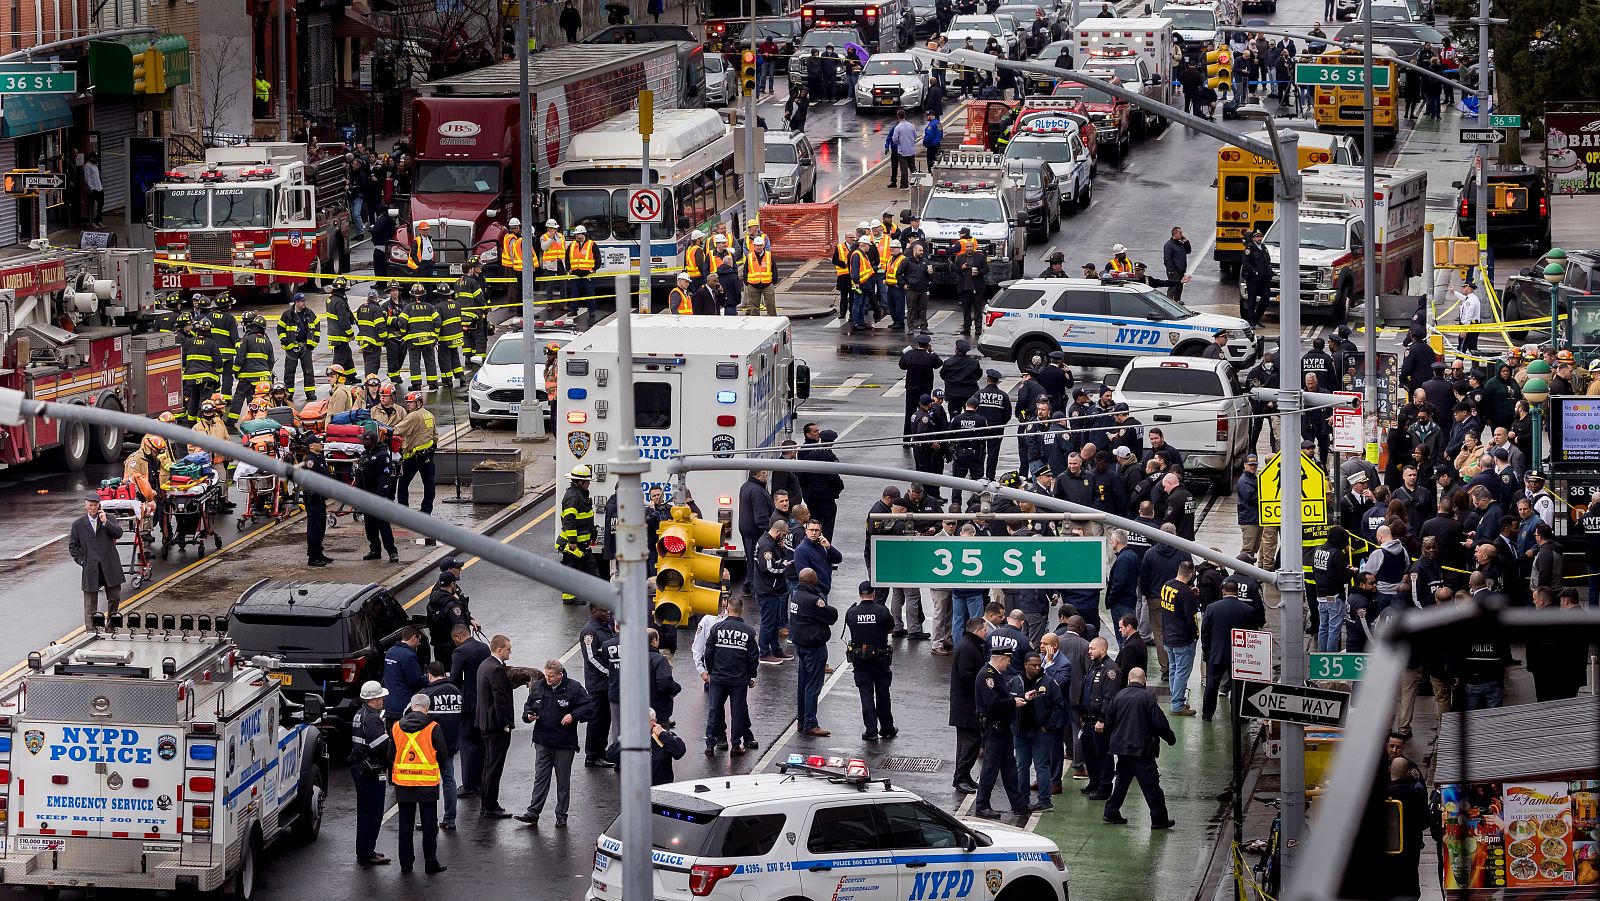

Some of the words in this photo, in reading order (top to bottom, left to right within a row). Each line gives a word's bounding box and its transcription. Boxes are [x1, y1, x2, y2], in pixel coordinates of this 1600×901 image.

[1319, 68, 1340, 82] 36
[1346, 69, 1365, 82] St
[6, 76, 27, 90] 36
[34, 76, 52, 89] St
[1493, 116, 1505, 126] 36
[444, 124, 473, 133] JBS
[440, 138, 476, 146] CARRIERS
[1586, 152, 1600, 164] OP
[2, 272, 24, 289] LADDER
[24, 272, 32, 288] 114
[42, 268, 57, 285] TALLY
[162, 275, 182, 288] 201
[1114, 328, 1161, 345] NYPD
[100, 368, 116, 386] FDNY
[980, 392, 1004, 401] NYPD
[638, 449, 681, 460] OLICE
[641, 482, 672, 492] OMB
[1570, 486, 1585, 496] 36
[1264, 504, 1322, 518] SCOL
[1314, 549, 1330, 561] NYPD
[932, 548, 984, 577] 35
[1002, 548, 1047, 577] St
[1314, 560, 1328, 568] POLICE
[1160, 584, 1178, 603] ATF
[717, 629, 749, 642] NYPD
[992, 635, 1018, 649] NYPD
[717, 639, 746, 647] POLICE
[1472, 644, 1494, 652] POLICE
[1319, 656, 1344, 678] 35
[1258, 694, 1288, 710] ONE
[1302, 698, 1334, 716] WAY
[240, 708, 262, 746] POLICE
[62, 727, 140, 746] NYPD
[50, 745, 152, 764] POLICE
[46, 796, 108, 810] EMERGENCY
[112, 798, 154, 811] SERVICE
[1520, 791, 1564, 806] Familia
[603, 839, 620, 851] NYPD
[1477, 835, 1500, 844] 4-8pm
[1017, 852, 1043, 862] POLICE
[744, 864, 760, 874] 4395
[767, 864, 778, 872] ESU
[779, 862, 791, 871] K-9
[840, 875, 866, 884] COURTESY
[908, 869, 974, 900] NYPD
[835, 884, 880, 893] PROFESSIONALISM
